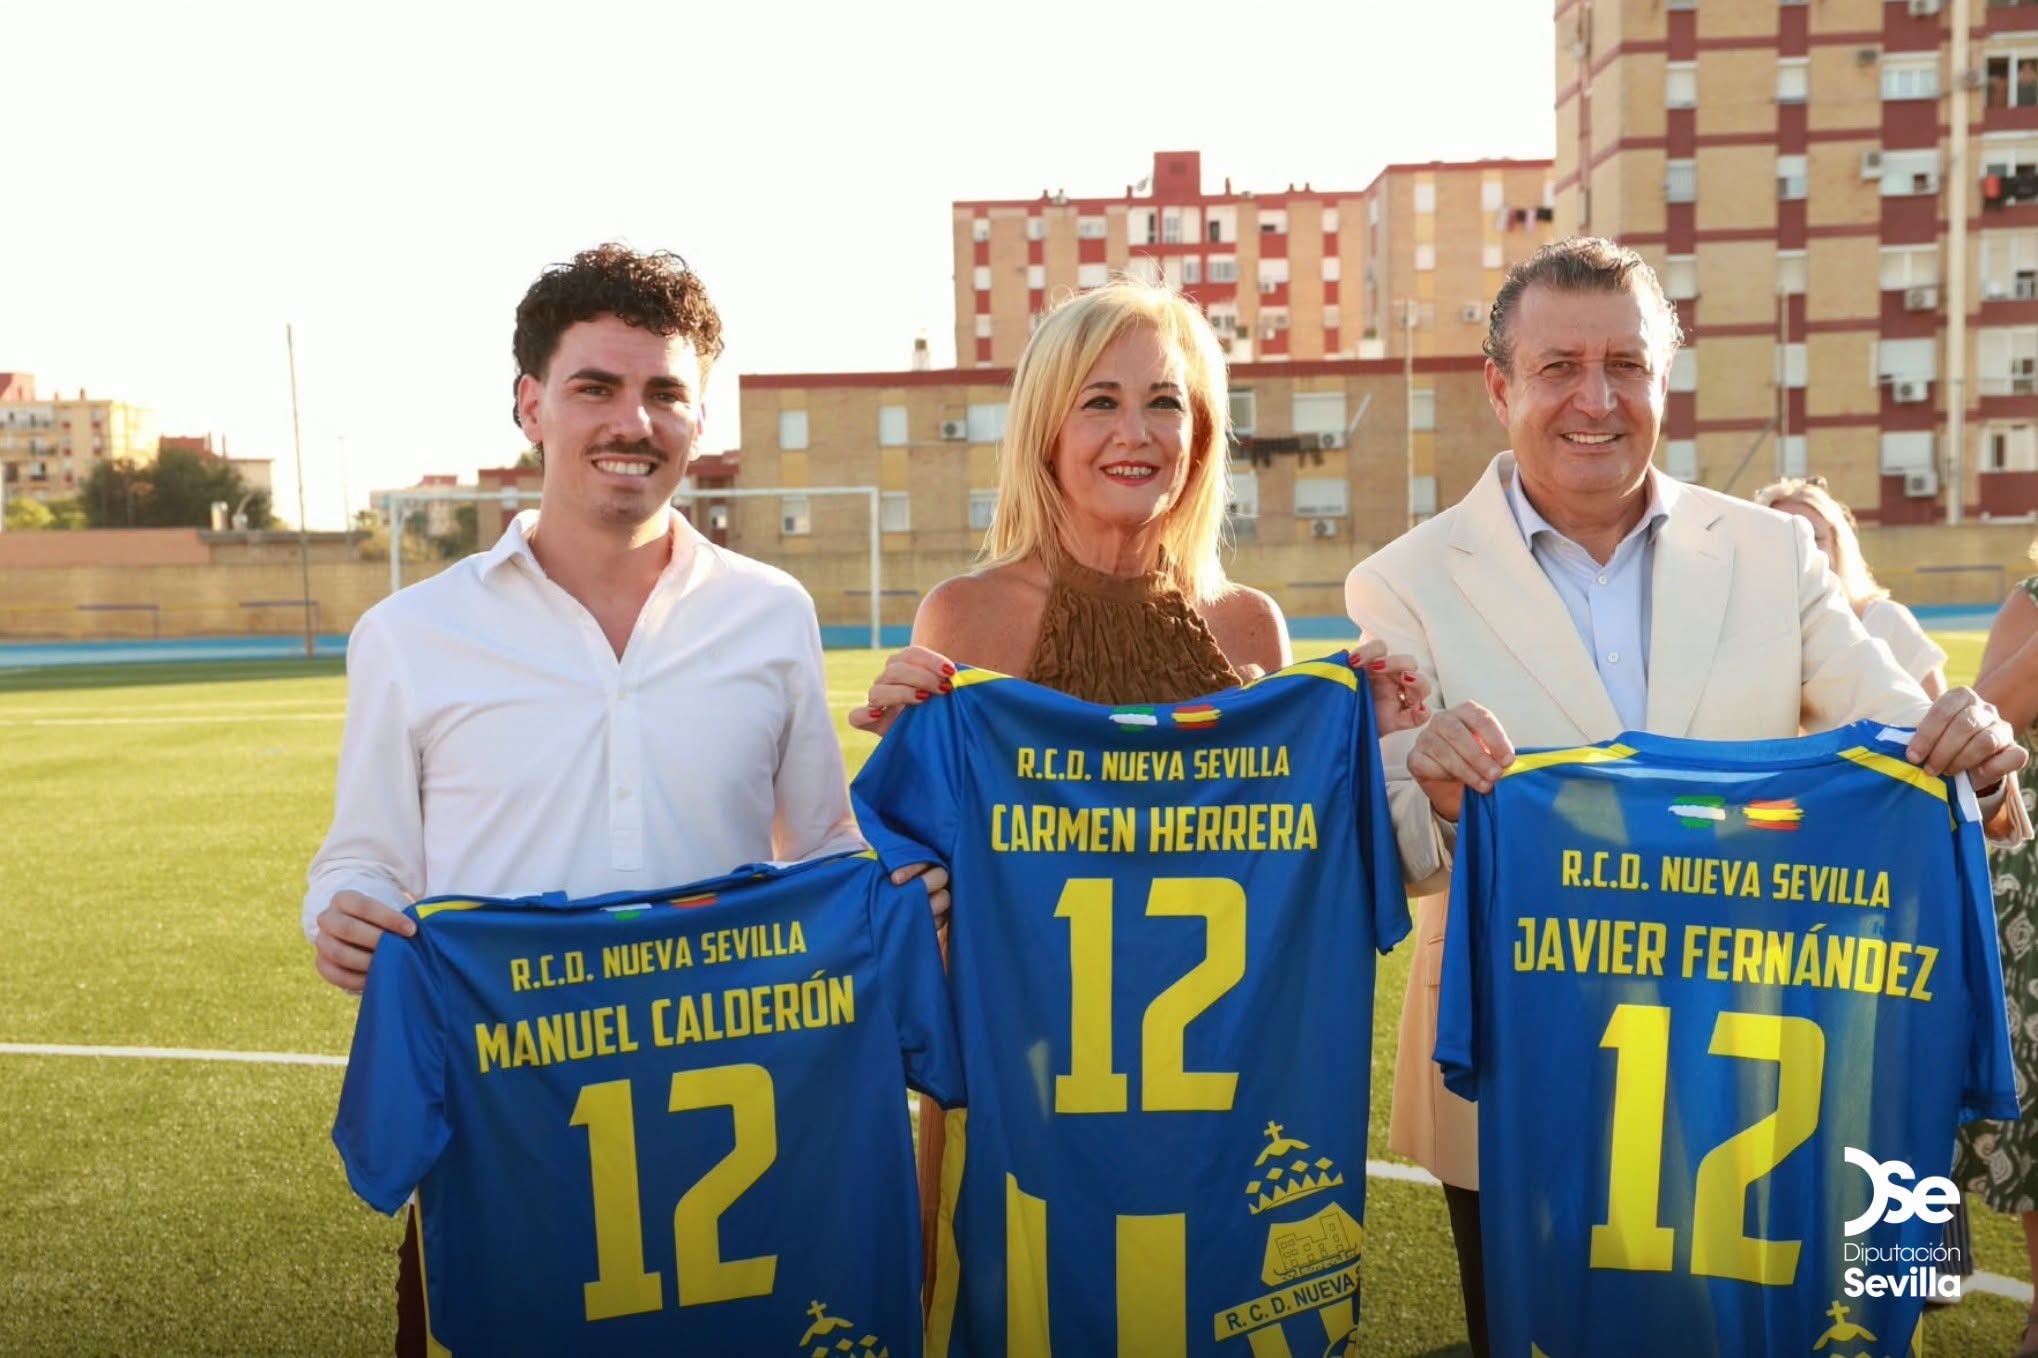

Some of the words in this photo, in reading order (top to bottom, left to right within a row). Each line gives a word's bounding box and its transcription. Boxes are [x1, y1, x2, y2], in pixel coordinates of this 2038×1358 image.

[1017, 748, 1091, 780] R.C.D.
[1102, 750, 1184, 781] NUEVA
[1194, 746, 1290, 779] SEVILLA
[991, 804, 1136, 853] CARMEN
[1149, 803, 1318, 853] HERRERA
[1562, 849, 1649, 891] R.C.D.
[1660, 855, 1760, 898] NUEVA
[1773, 862, 1890, 908] SEVILLA
[511, 953, 594, 991] R.C.D.
[603, 936, 693, 978] NUEVA
[701, 921, 806, 965] SEVILLA
[1514, 916, 1666, 977] JAVIER
[1682, 923, 1939, 1001] FERNÁNDEZ
[475, 1005, 638, 1073] MANUEL
[652, 971, 855, 1047] CALDERÓN
[1053, 877, 1246, 1113] 12
[1590, 1003, 1825, 1286] 12
[569, 1062, 778, 1322] 12
[1293, 1273, 1355, 1307] NUEVA
